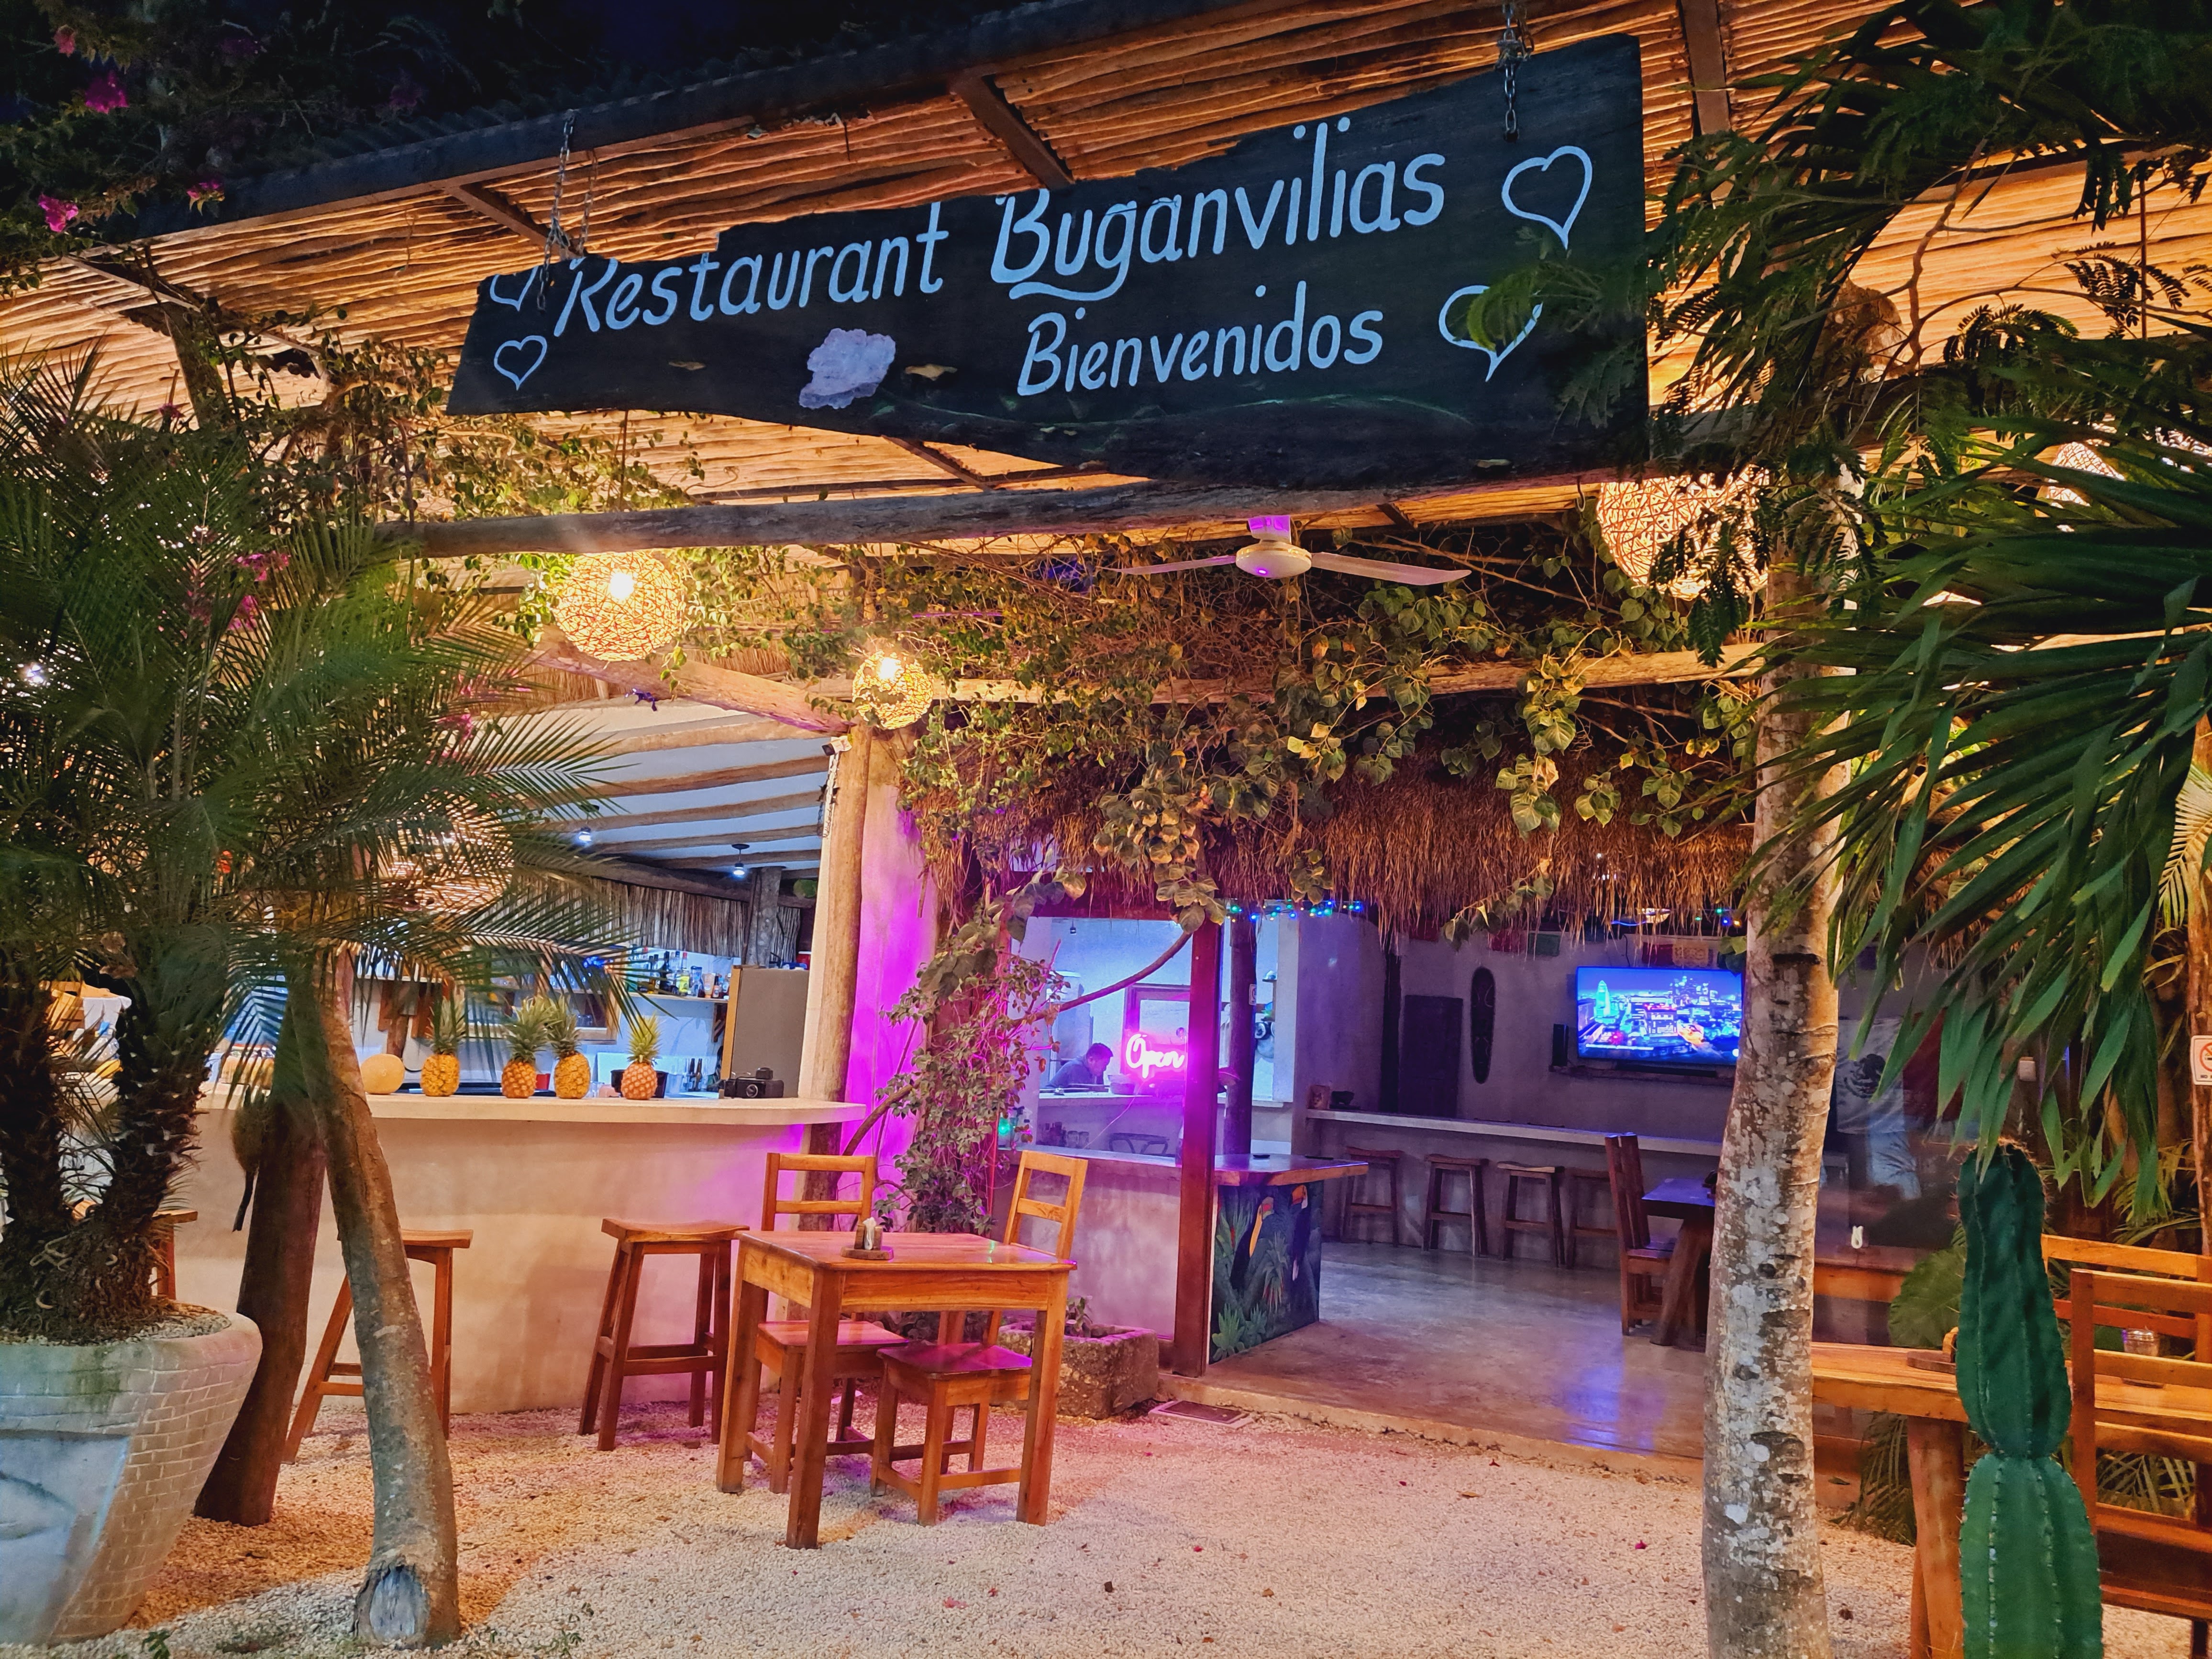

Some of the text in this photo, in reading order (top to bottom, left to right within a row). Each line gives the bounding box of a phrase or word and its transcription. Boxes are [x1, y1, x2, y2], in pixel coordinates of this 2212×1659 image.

[553, 117, 1446, 338] Restaurant Buganvilias
[1017, 280, 1383, 396] Bienvenidos
[1126, 1033, 1185, 1079] Open
